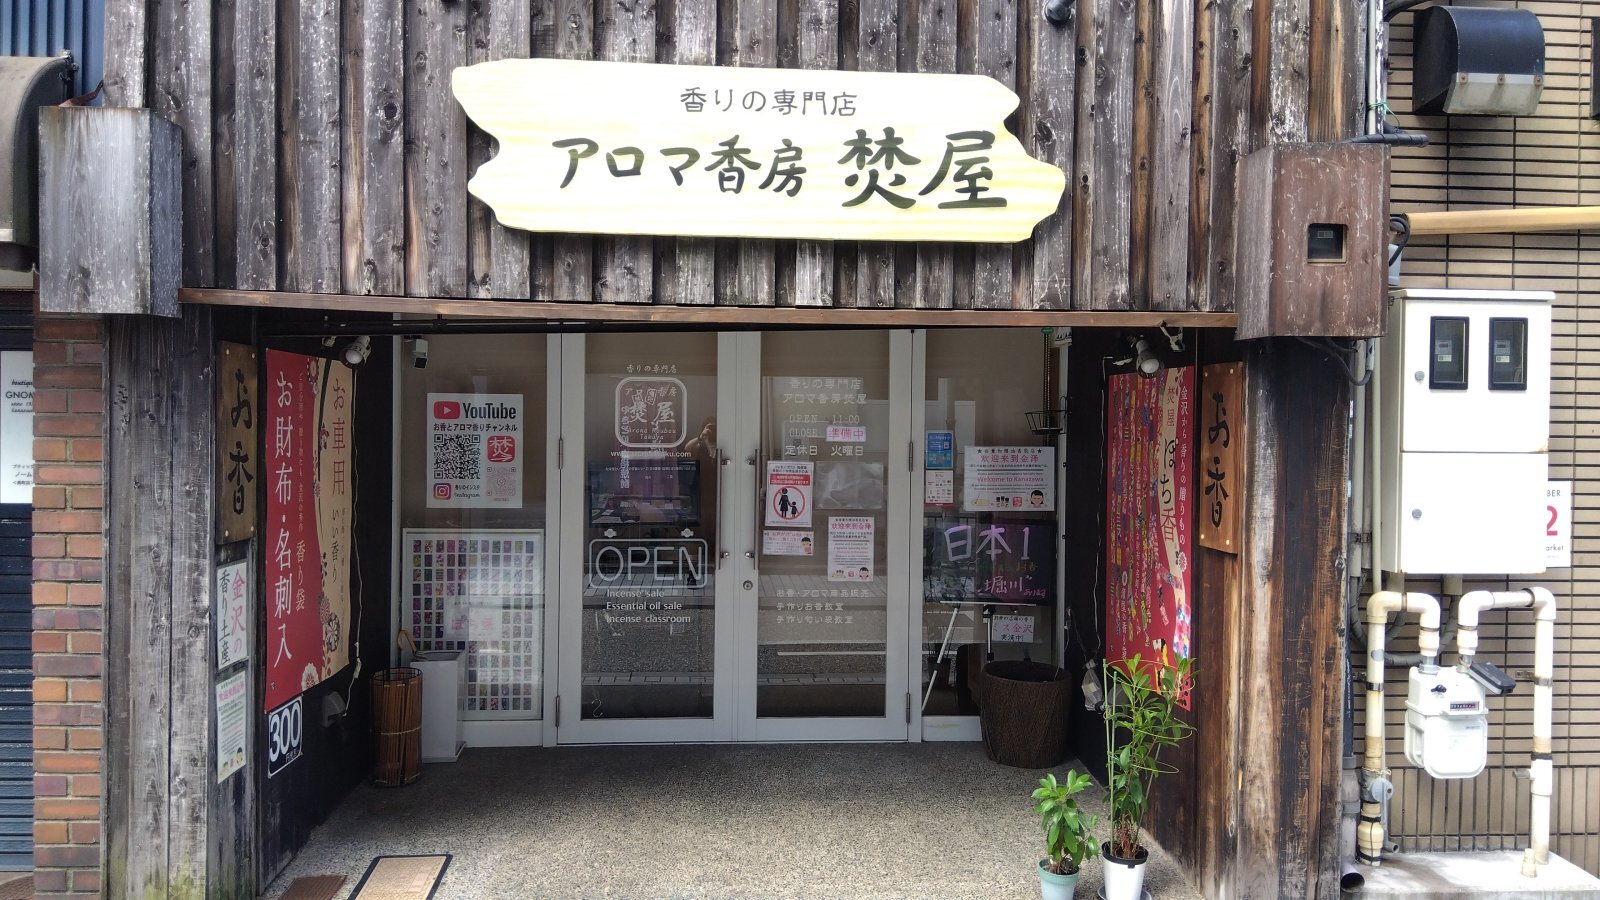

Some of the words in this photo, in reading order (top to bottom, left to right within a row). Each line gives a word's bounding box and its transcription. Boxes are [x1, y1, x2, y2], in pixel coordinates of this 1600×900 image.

[679, 87, 858, 117] 香りの専門店
[551, 134, 808, 197] アロマ香房
[837, 126, 1007, 210] 焚屋
[626, 364, 677, 374] 香りの専門店
[789, 378, 862, 390] 香りの専門店
[462, 402, 517, 420] YouTube
[332, 377, 346, 496] お車用
[433, 423, 518, 432] お香とアロマ香りチャンネル
[828, 427, 864, 440] 準備中
[227, 367, 255, 516] お香
[784, 445, 818, 456] 定休日
[830, 445, 864, 456] 火曜日
[1204, 391, 1230, 529] お香
[595, 545, 703, 582] OPEN
[606, 588, 642, 598] Incense
[644, 588, 665, 598] sale
[218, 568, 231, 666] 香り土産
[230, 569, 246, 654] 金沢の
[606, 601, 647, 610] Essential
[649, 601, 661, 610] oil
[663, 601, 683, 610] sale
[644, 613, 691, 623] classroom
[269, 701, 300, 763] 300
